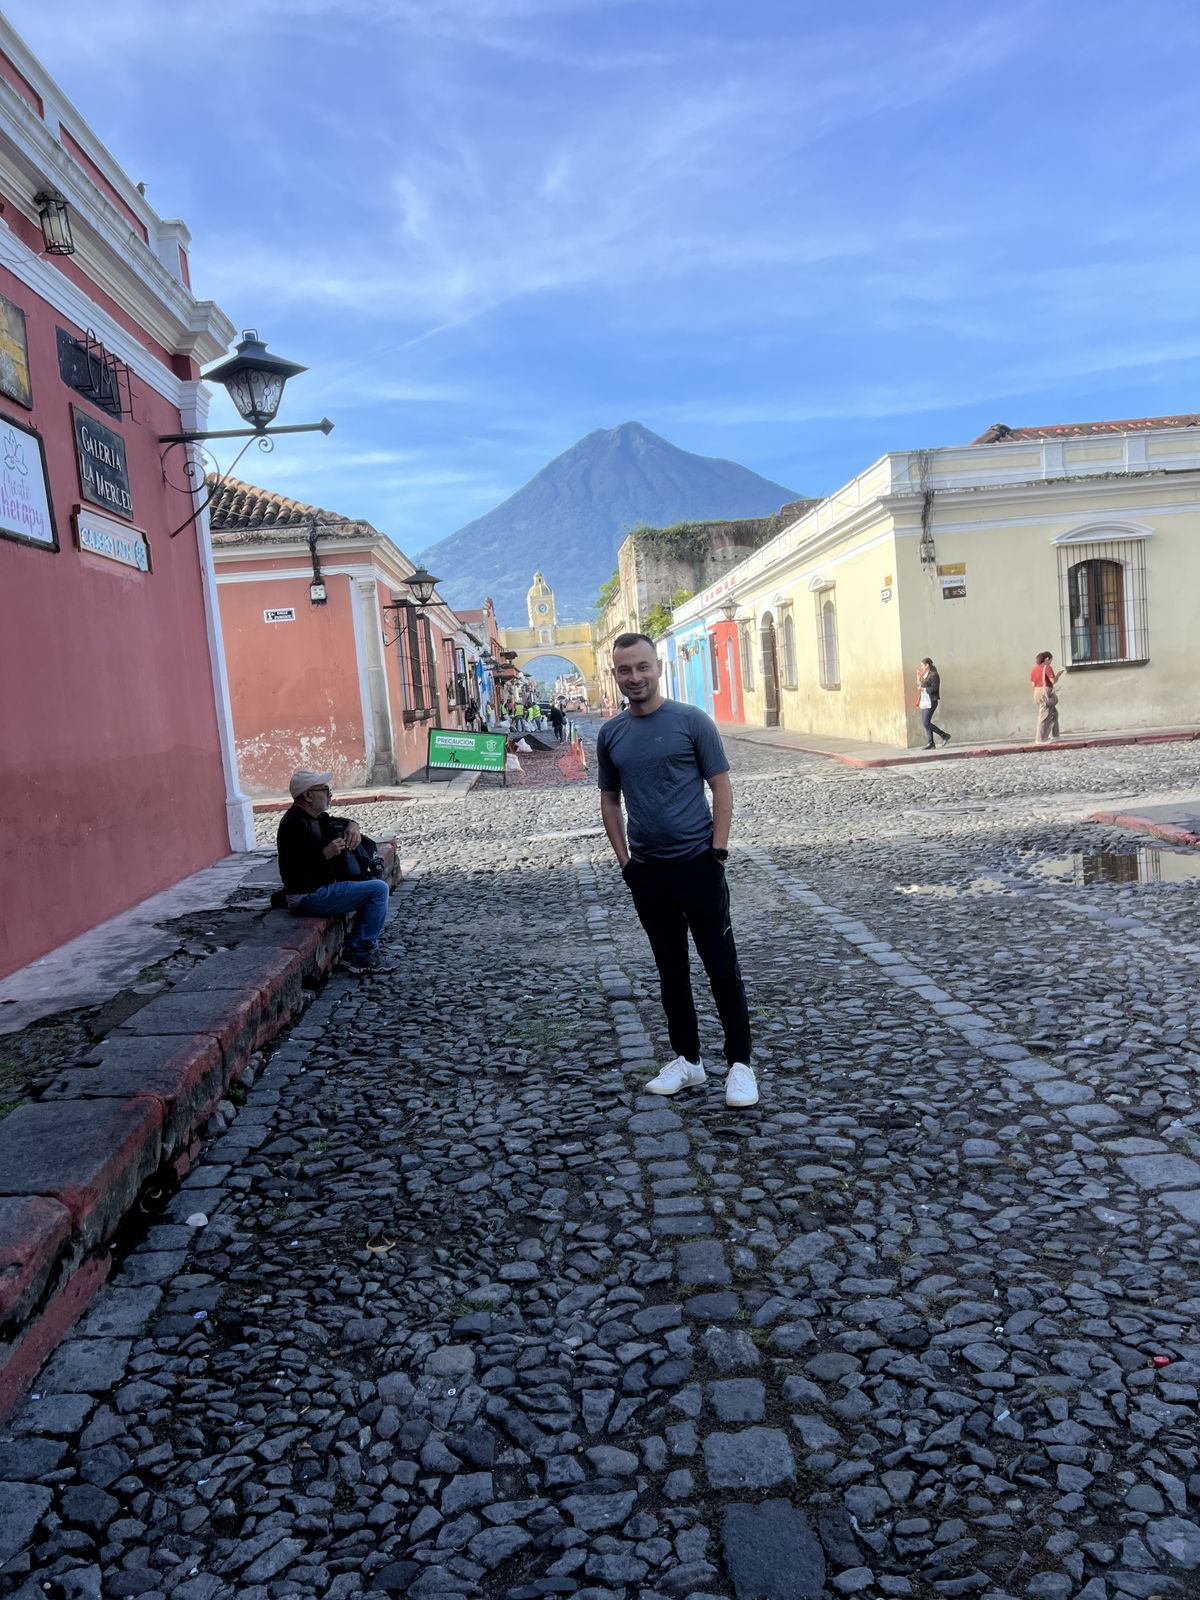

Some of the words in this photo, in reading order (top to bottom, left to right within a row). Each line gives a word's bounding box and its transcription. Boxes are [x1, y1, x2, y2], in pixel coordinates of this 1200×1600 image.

[81, 426, 122, 472] GALERIA
[80, 453, 95, 484] LA
[95, 471, 133, 511] MERCED
[0, 487, 45, 537] herapy
